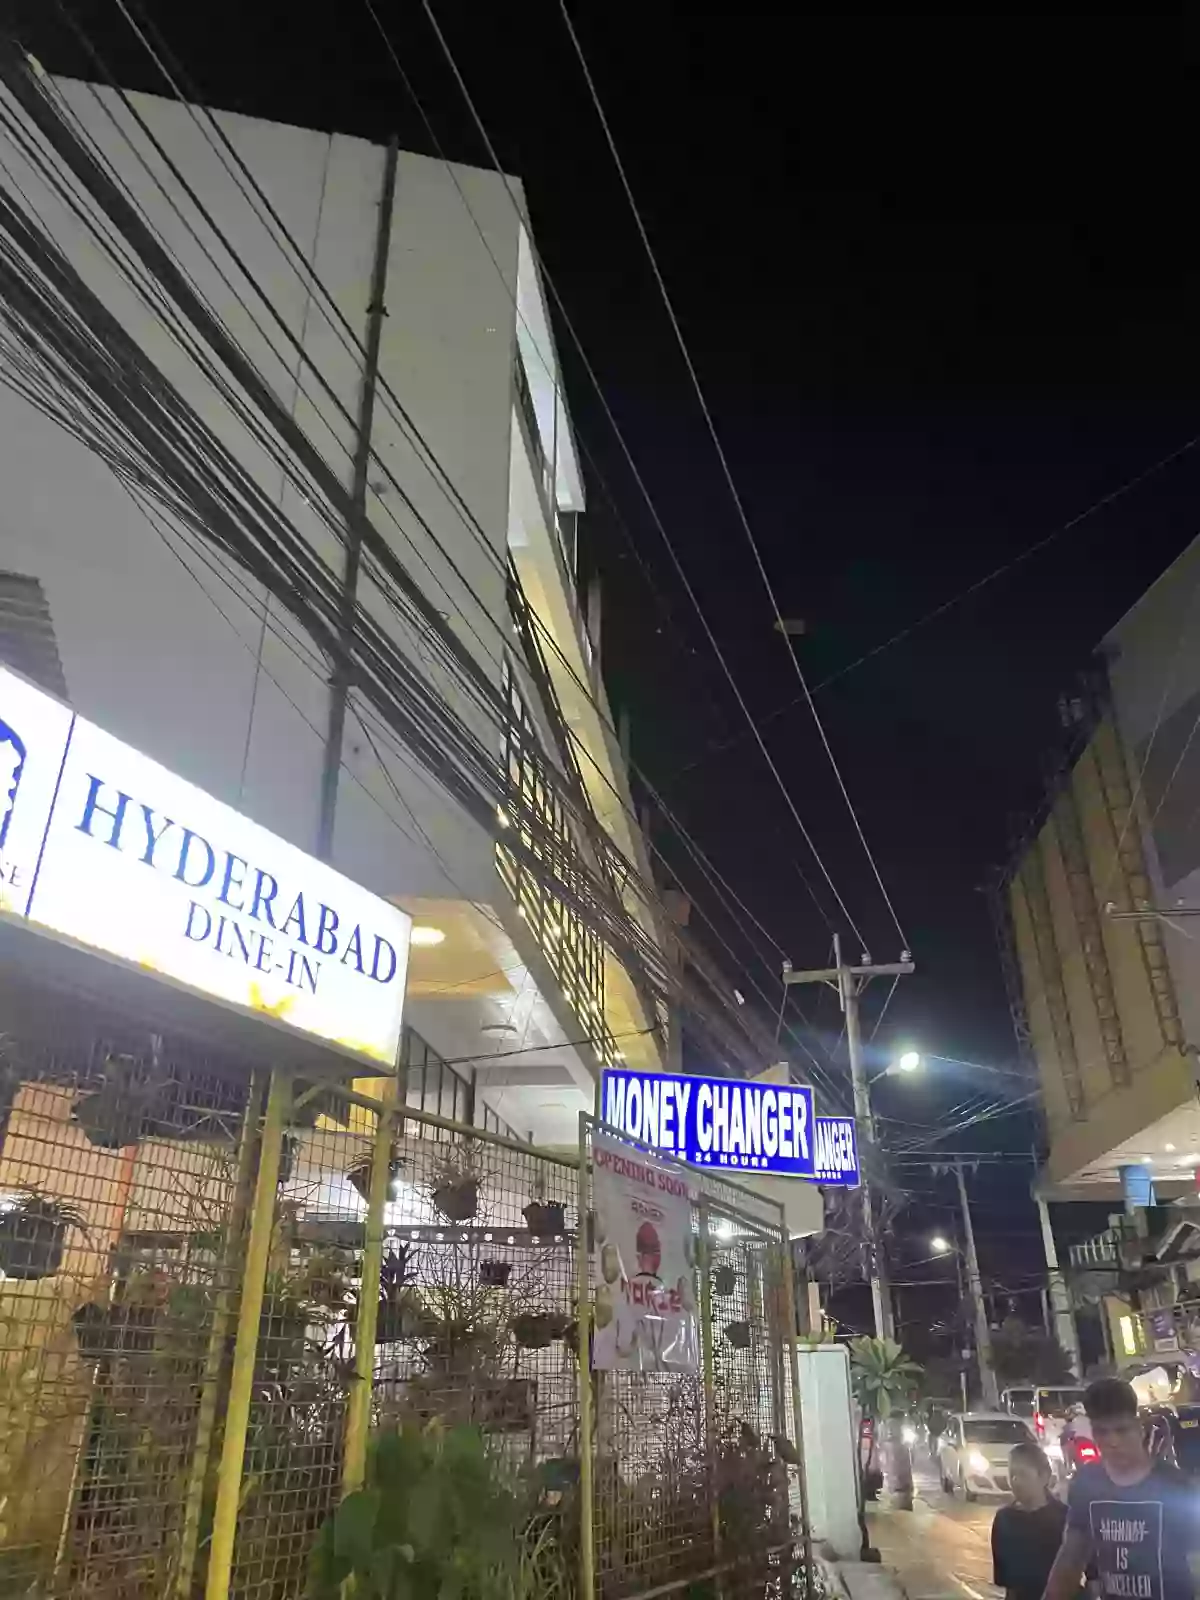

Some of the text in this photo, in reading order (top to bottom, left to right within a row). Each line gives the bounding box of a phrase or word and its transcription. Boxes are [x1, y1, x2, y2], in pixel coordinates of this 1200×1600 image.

[74, 772, 398, 985] HYDERABAD
[184, 899, 323, 995] DINE-IN
[605, 1076, 809, 1160] MONEY CHANGER
[593, 1146, 656, 1188] OPENING
[695, 1151, 712, 1163] 24
[1100, 1518, 1147, 1542] MONDAY
[1116, 1548, 1128, 1570] IS
